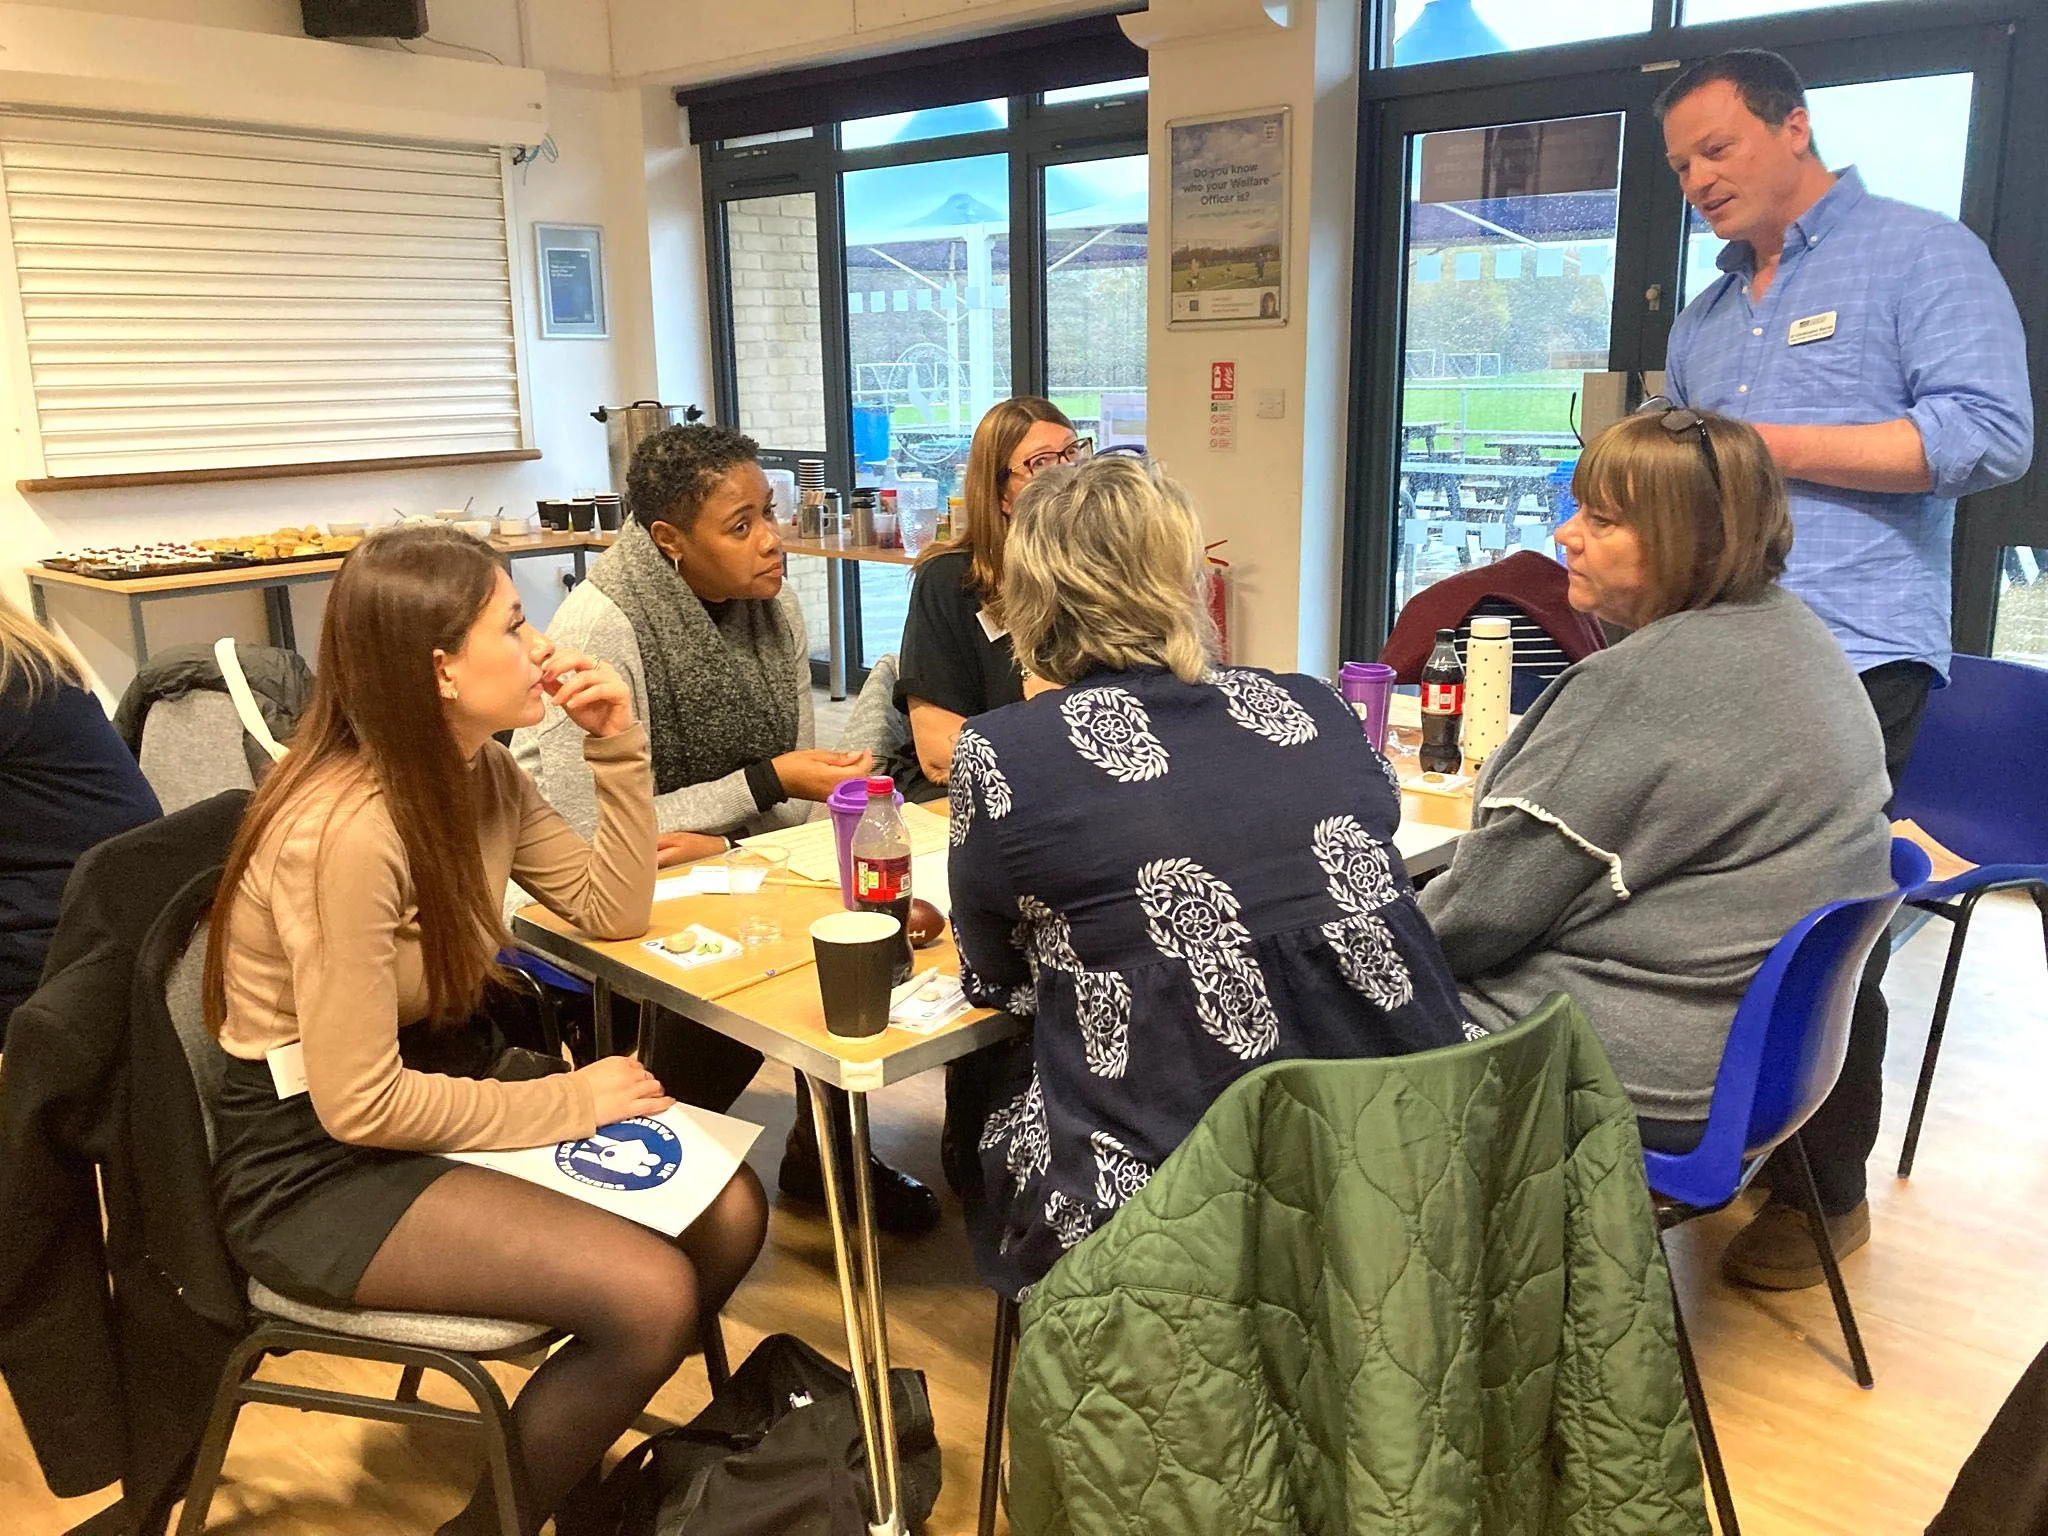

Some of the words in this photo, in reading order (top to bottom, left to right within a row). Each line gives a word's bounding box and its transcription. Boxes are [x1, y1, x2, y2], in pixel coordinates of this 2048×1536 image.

[1193, 168, 1207, 178] Do
[1212, 166, 1228, 178] you
[1231, 163, 1258, 174] know
[1183, 182, 1203, 193] who
[1206, 180, 1227, 192] your
[1231, 177, 1270, 189] Welfare
[1201, 194, 1235, 205] Officer
